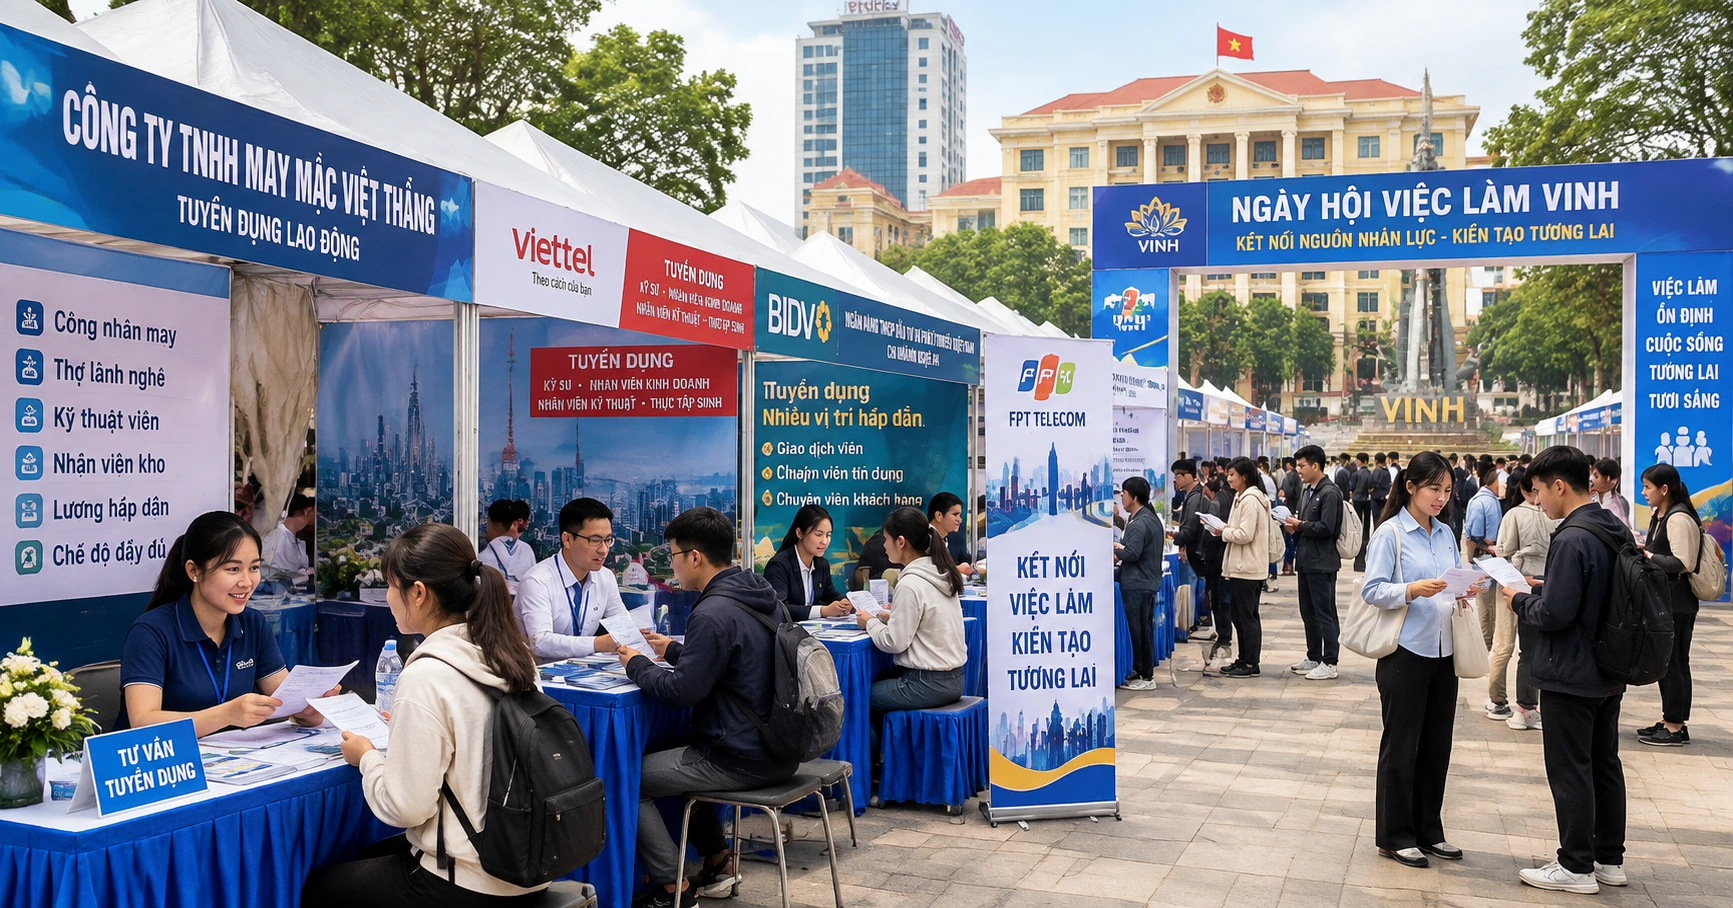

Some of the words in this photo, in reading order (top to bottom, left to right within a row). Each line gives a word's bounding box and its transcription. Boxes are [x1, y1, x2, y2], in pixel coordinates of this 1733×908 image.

[63, 81, 137, 160] CÔNG
[143, 112, 173, 168] TY
[179, 123, 238, 186] TNHH
[245, 143, 290, 198] MAY
[342, 165, 379, 227] VIỆT
[1232, 188, 1311, 223] NGÀY
[1321, 185, 1371, 225] HỘI
[1382, 181, 1452, 223] VIỆC
[1463, 178, 1530, 215] LÀM
[1542, 181, 1619, 211] VINH
[287, 220, 316, 251] LAO
[319, 226, 360, 262] ĐỘNG
[1138, 238, 1179, 253] VINH
[1494, 226, 1525, 246] TẠO
[1589, 223, 1615, 239] LAI
[512, 227, 595, 277] Viettel
[54, 310, 97, 341] Công
[103, 318, 141, 341] nhân
[768, 293, 816, 340] BIDV
[1698, 364, 1719, 380] LAI
[646, 378, 670, 390] KINH
[673, 378, 710, 390] DOANH
[824, 381, 870, 404] dụng
[81, 408, 123, 434] thuật
[128, 410, 159, 430] viên
[833, 407, 853, 426] trí
[1009, 411, 1031, 427] FPT
[1033, 411, 1086, 427] TELECOM
[1381, 396, 1464, 423] VINH
[777, 442, 805, 455] Giao
[139, 453, 166, 474] kho
[824, 492, 850, 506] viên
[1009, 587, 1050, 621] VIỆC
[117, 744, 139, 767] TƯ
[157, 762, 196, 789] DỤNG
